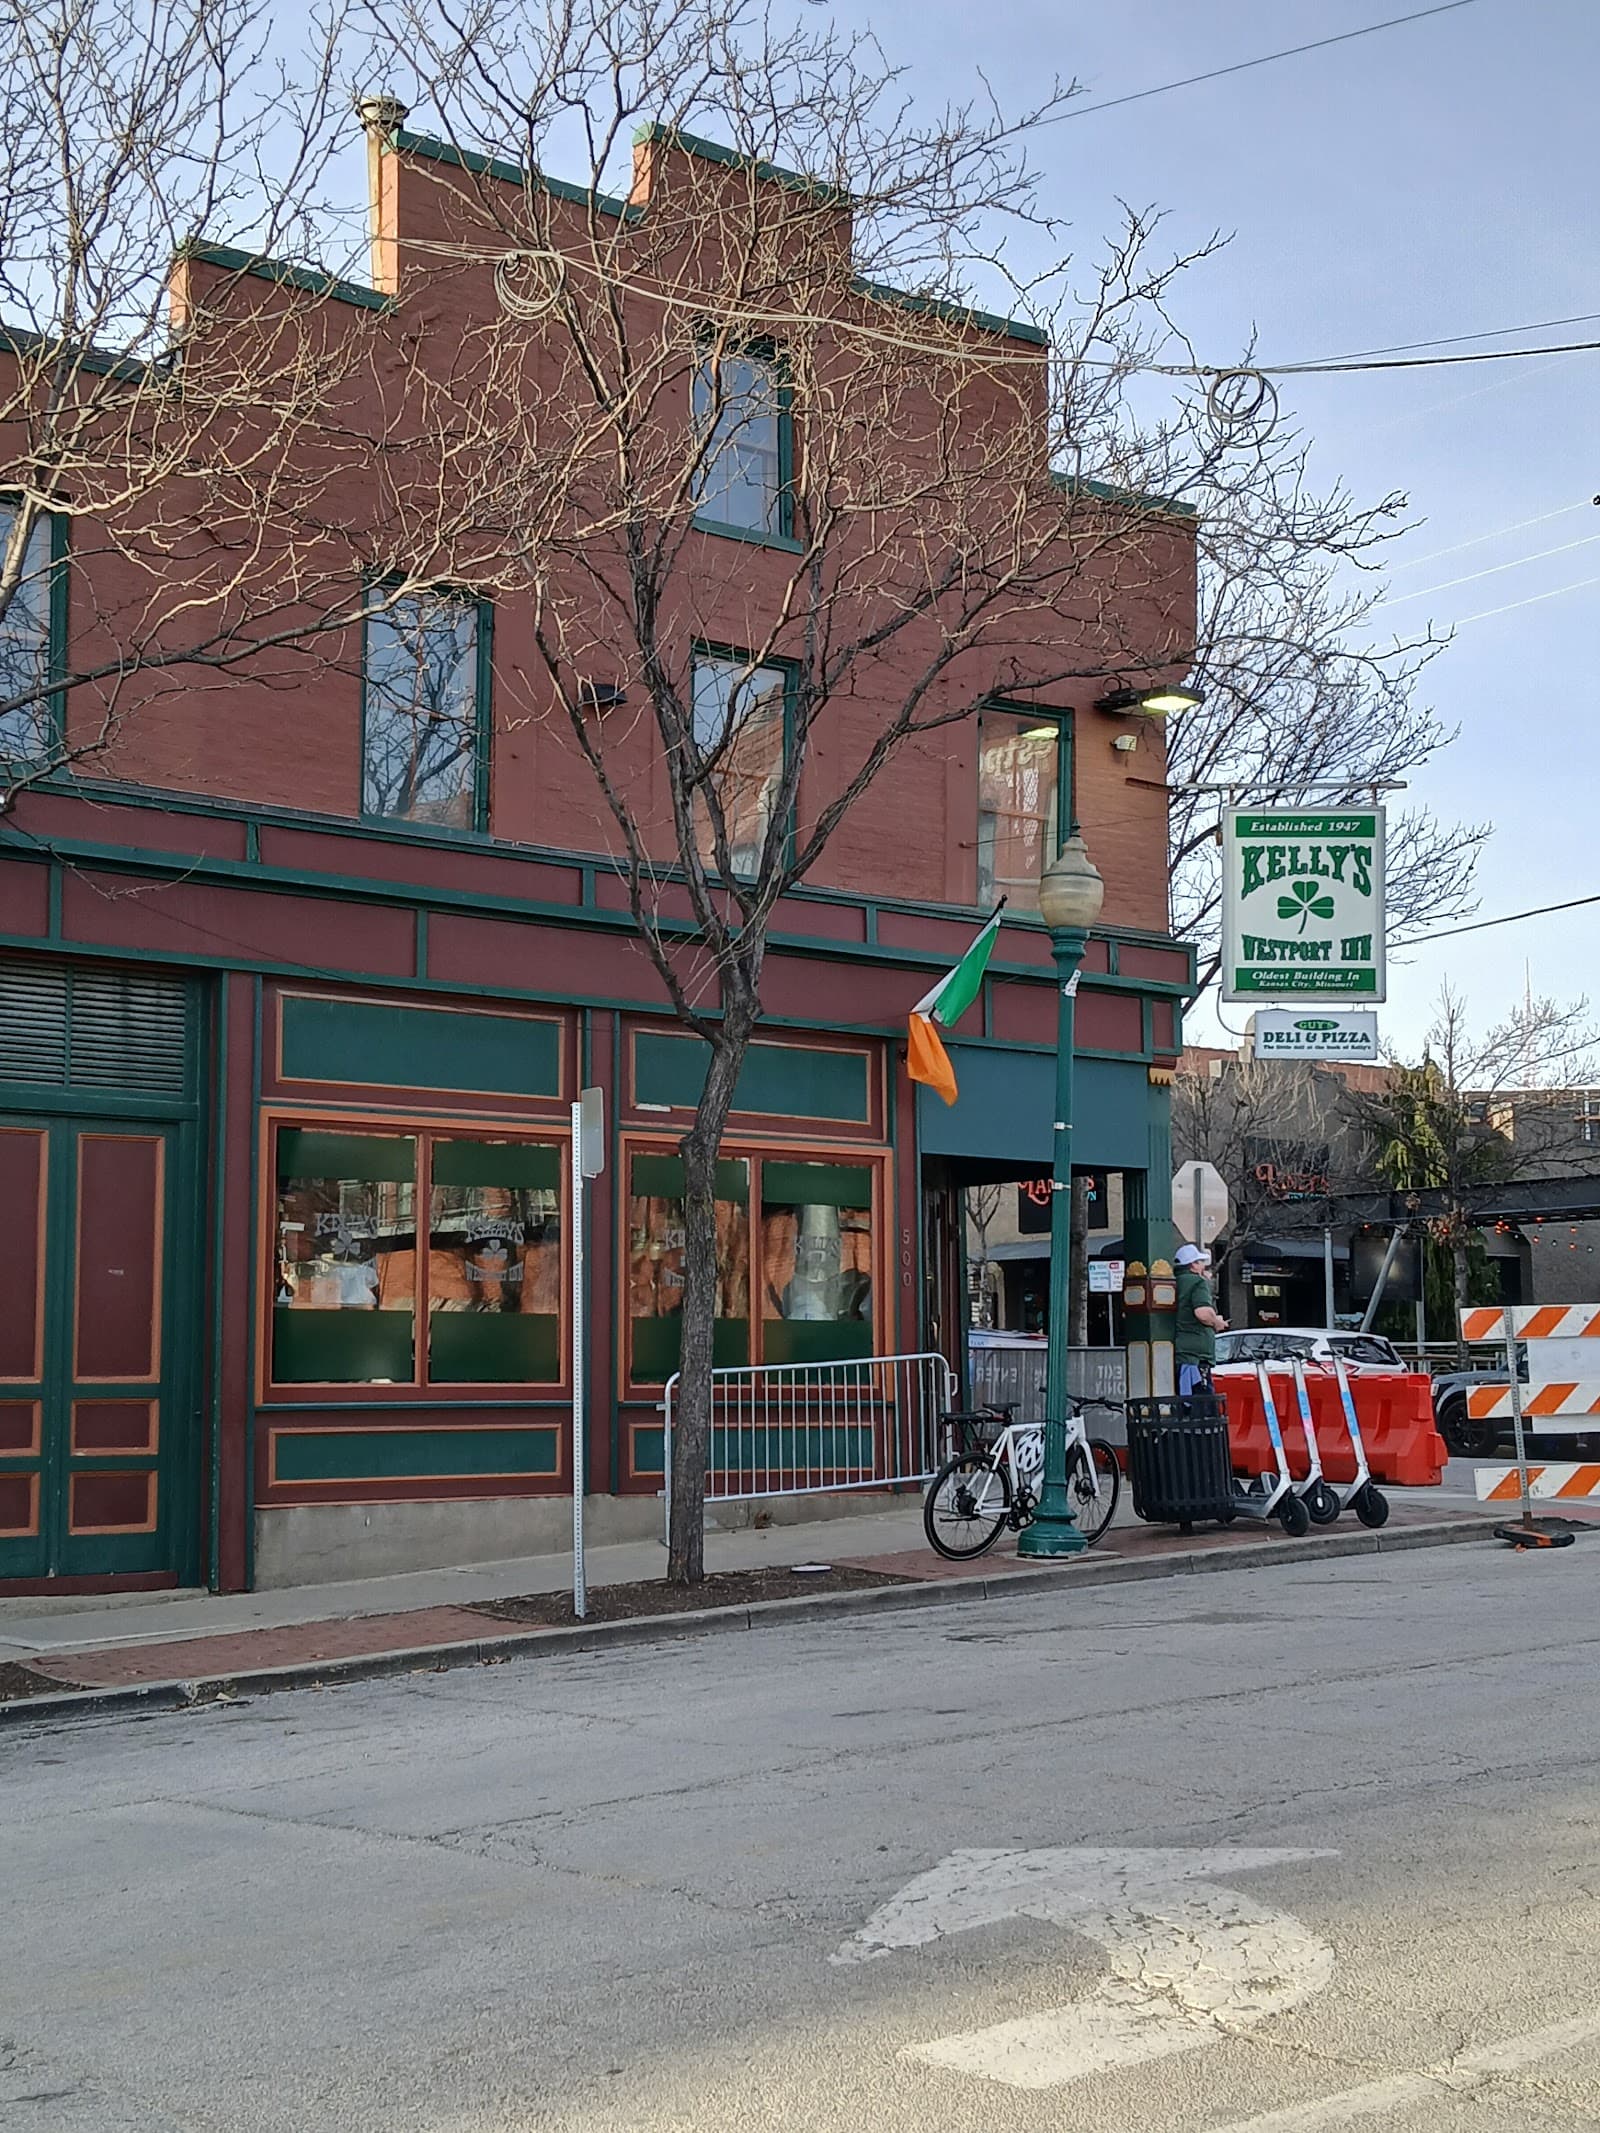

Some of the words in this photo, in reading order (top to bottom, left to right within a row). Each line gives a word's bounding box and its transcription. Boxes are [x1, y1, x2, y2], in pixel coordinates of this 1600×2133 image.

[1250, 821, 1324, 832] Established
[1328, 821, 1361, 832] 1947
[1241, 844, 1372, 900] KELLY'S
[1241, 934, 1333, 961] WESTPORT
[1252, 971, 1290, 980] Oldest
[1293, 971, 1343, 982] Building
[1347, 971, 1361, 980] In
[1315, 980, 1355, 988] Missouri
[1263, 1032, 1301, 1043] DELI
[1305, 1032, 1318, 1043] &
[1321, 1032, 1371, 1043] PIZZA
[902, 1229, 912, 1287] 500
